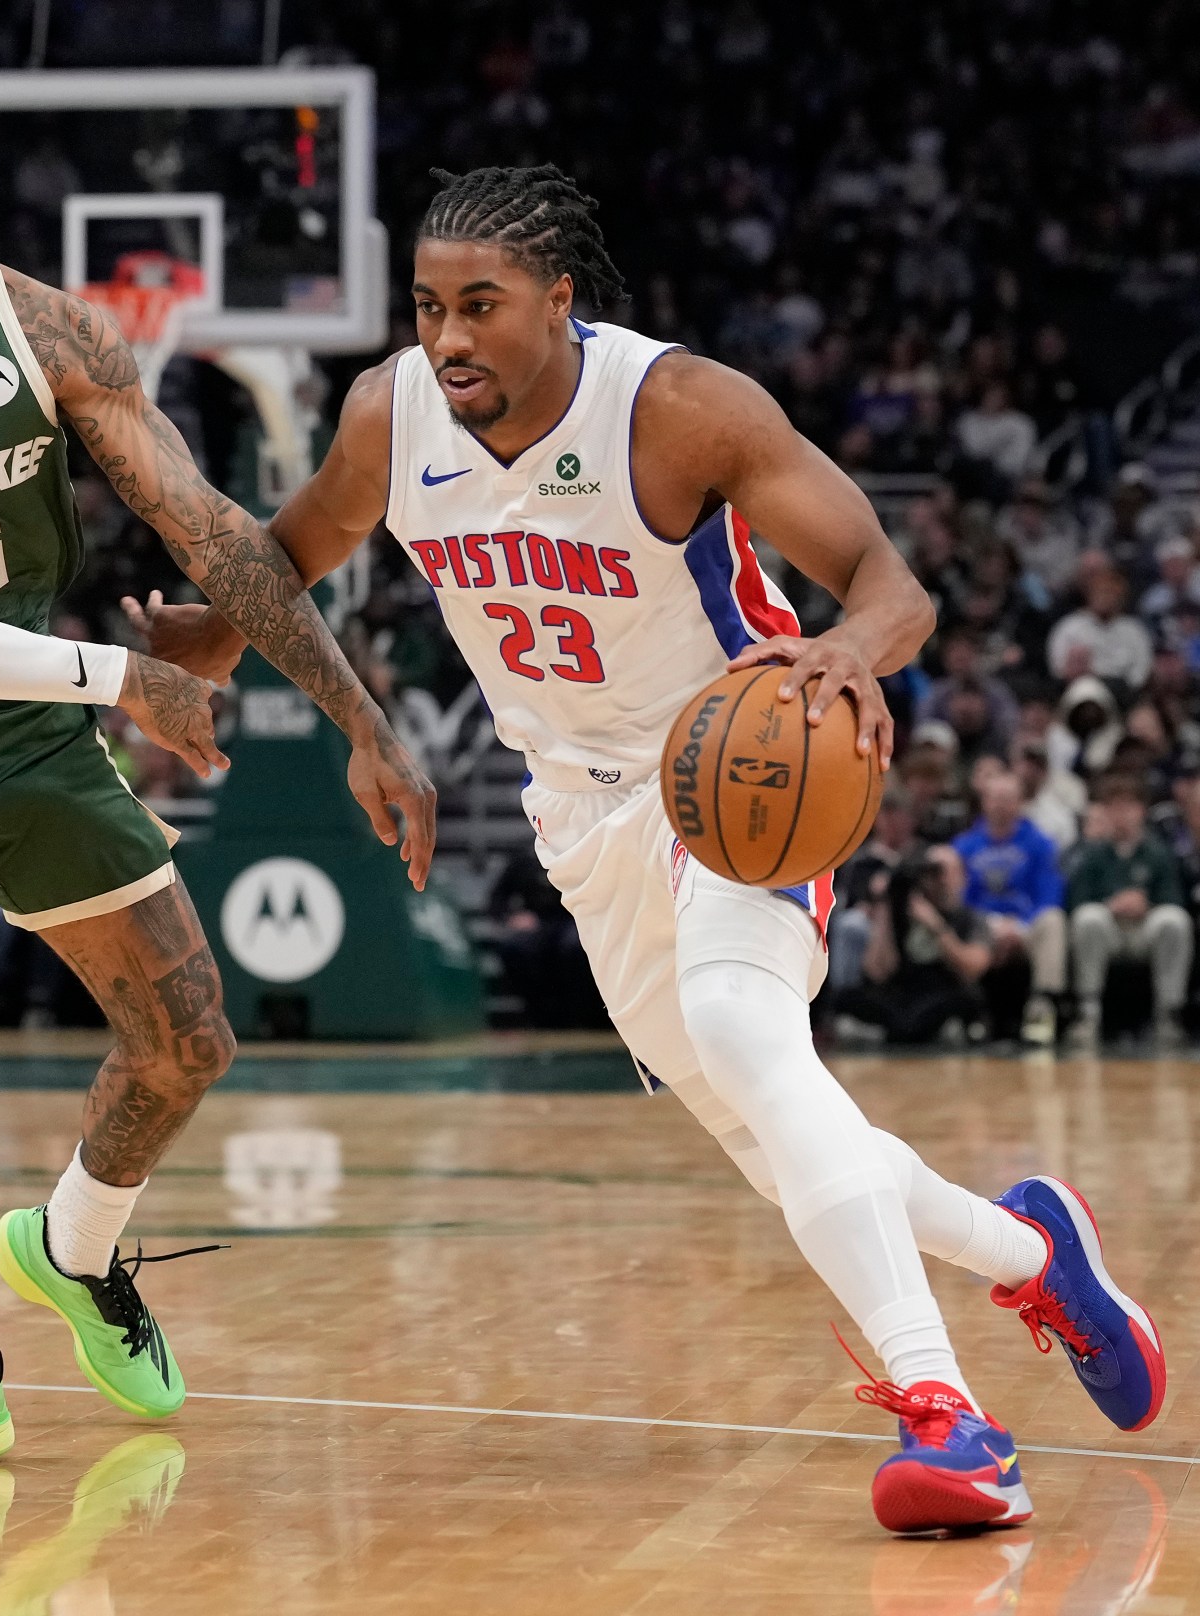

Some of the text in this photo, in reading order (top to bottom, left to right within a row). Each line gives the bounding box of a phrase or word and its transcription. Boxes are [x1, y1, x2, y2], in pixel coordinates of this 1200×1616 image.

[538, 481, 601, 496] StockX
[408, 530, 639, 598] PISTONS
[483, 602, 606, 683] 23
[673, 694, 728, 838] Wilson
